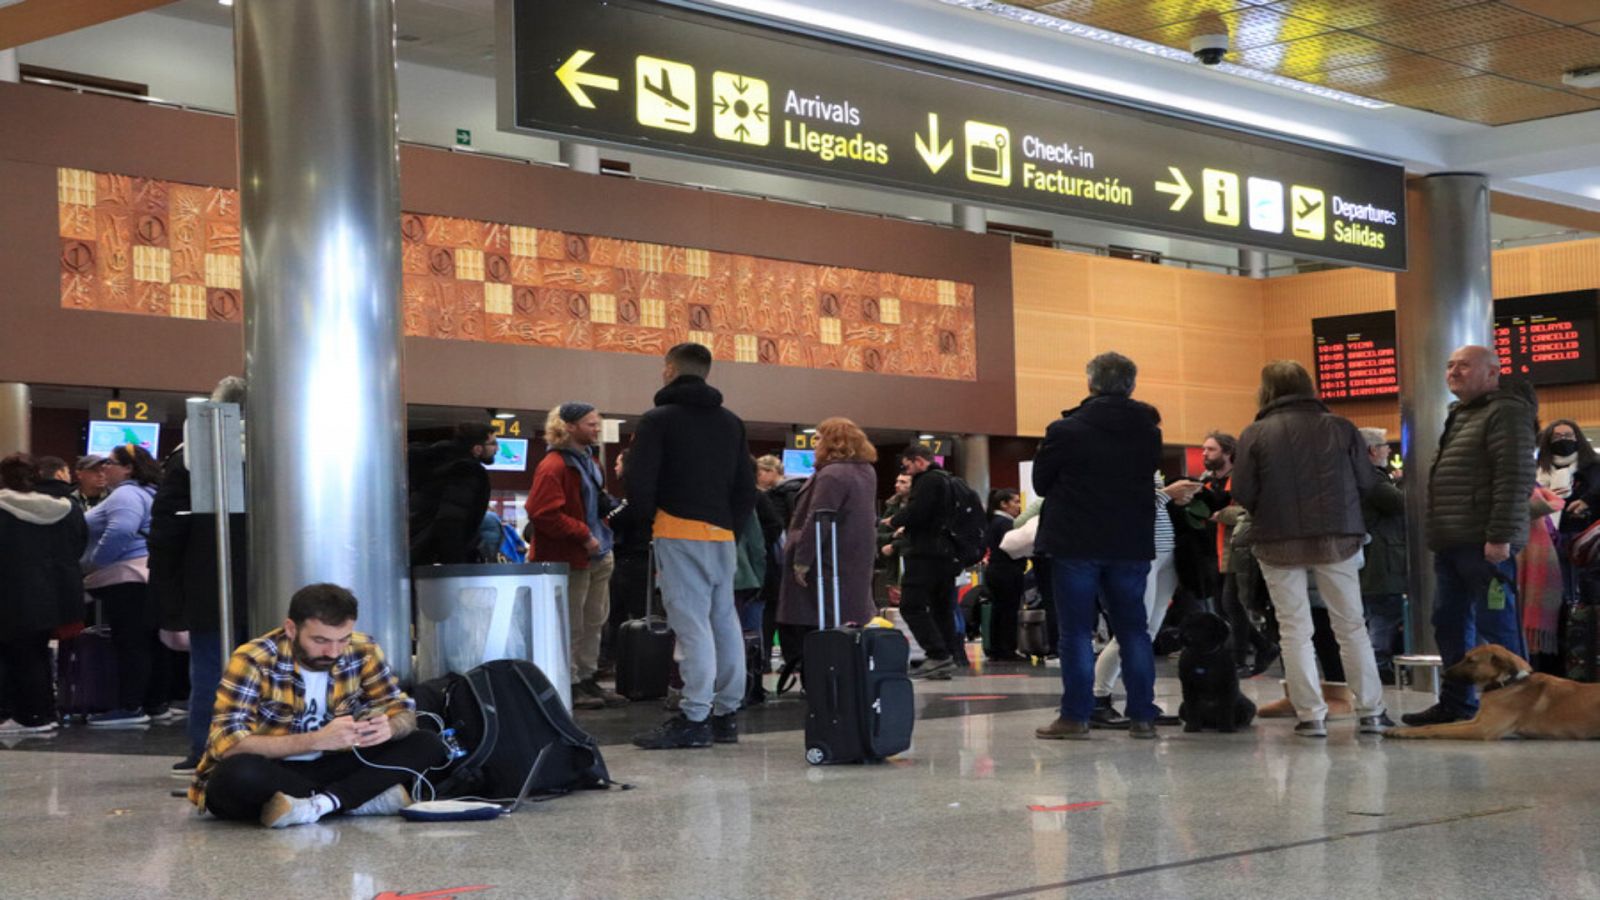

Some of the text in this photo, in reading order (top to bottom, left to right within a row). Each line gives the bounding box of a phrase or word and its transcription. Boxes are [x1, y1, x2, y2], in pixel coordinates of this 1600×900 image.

[784, 89, 861, 126] Arrivals
[784, 119, 889, 165] Llegadas
[1022, 135, 1094, 169] Check-in
[1023, 162, 1133, 206] Facturación
[1332, 195, 1397, 226] Departures
[1333, 219, 1386, 249] Salidas
[1530, 322, 1572, 332] DELAYED
[1531, 332, 1578, 342] CANCELED
[1347, 348, 1394, 360] BARCELONA
[1532, 341, 1580, 352] CANCELED
[1348, 358, 1394, 370] BARCELONA
[1532, 351, 1580, 362] CANCELED
[1348, 367, 1396, 378] BARCELONA
[134, 402, 149, 420] 2
[509, 420, 521, 436] 4
[934, 440, 942, 454] 7
